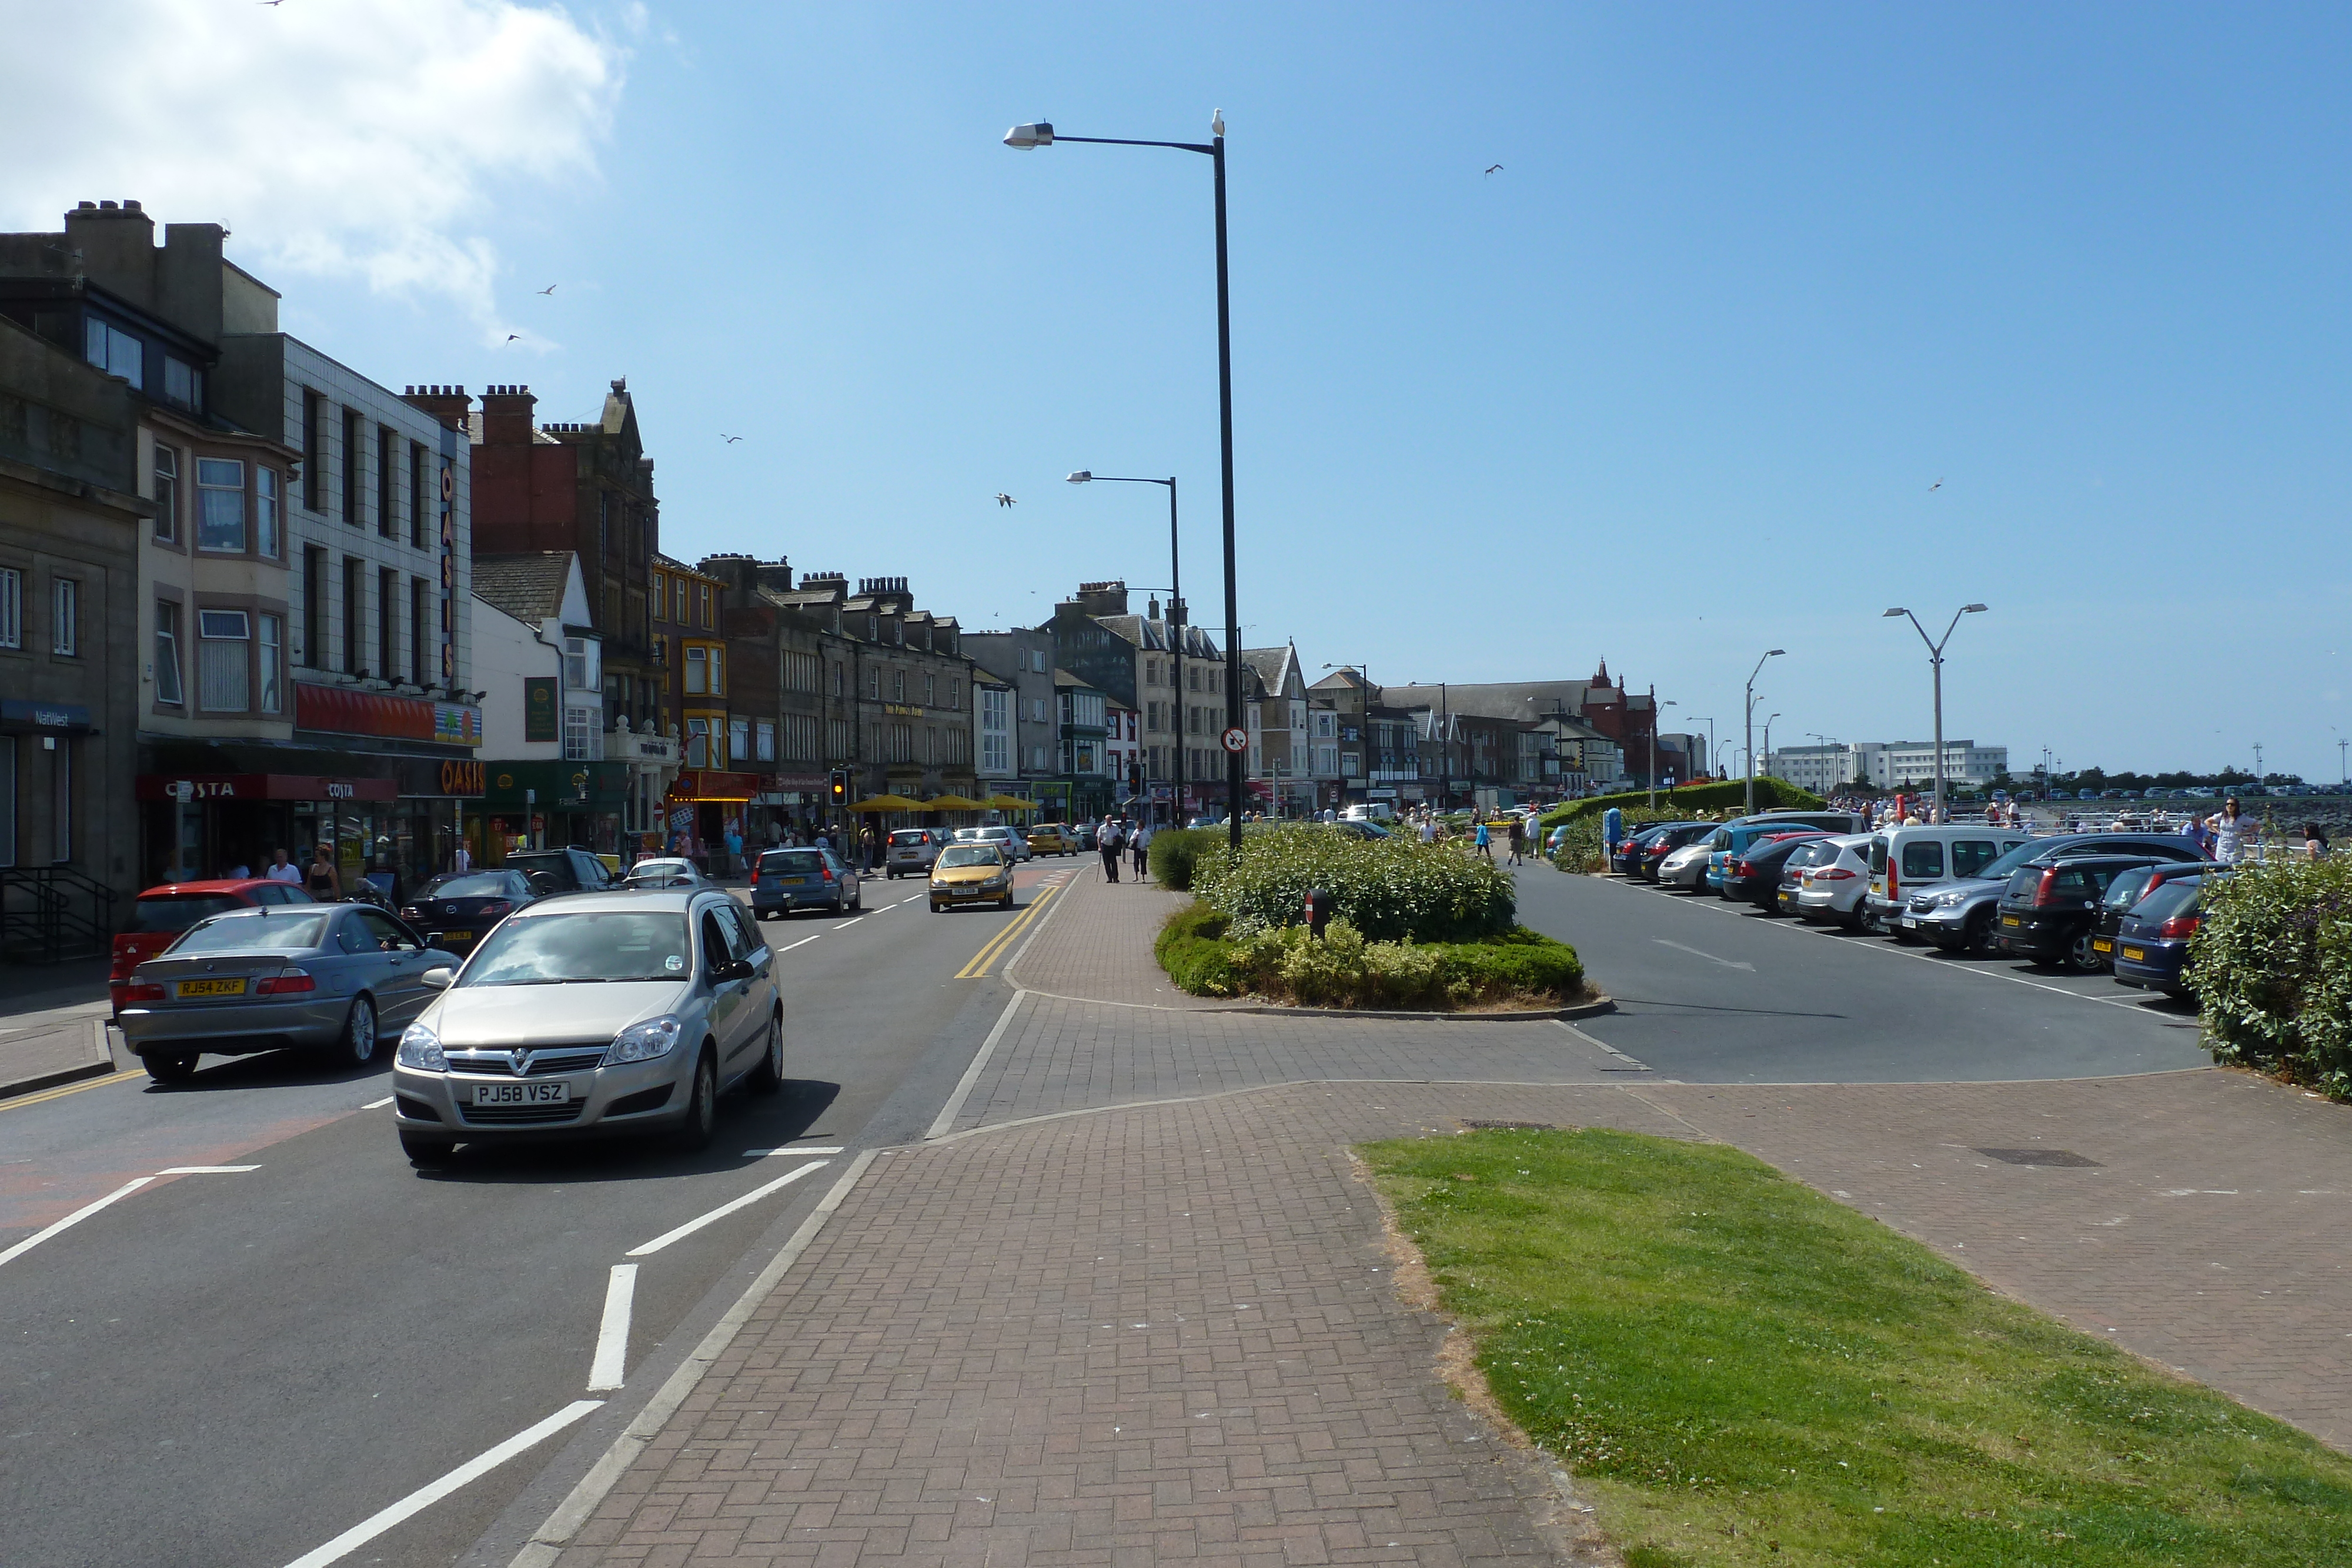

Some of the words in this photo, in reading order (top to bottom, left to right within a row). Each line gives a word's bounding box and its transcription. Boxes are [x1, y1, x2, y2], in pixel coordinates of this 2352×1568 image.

[442, 467, 453, 677] OASIS
[36, 710, 68, 727] NatWest
[441, 760, 485, 794] OASIS
[165, 783, 234, 798] CSTA
[328, 783, 353, 799] COSTA
[182, 980, 212, 994] RJ54
[216, 980, 240, 993] ZKF
[479, 1086, 523, 1102] PJ58
[528, 1085, 562, 1101] VSZ
